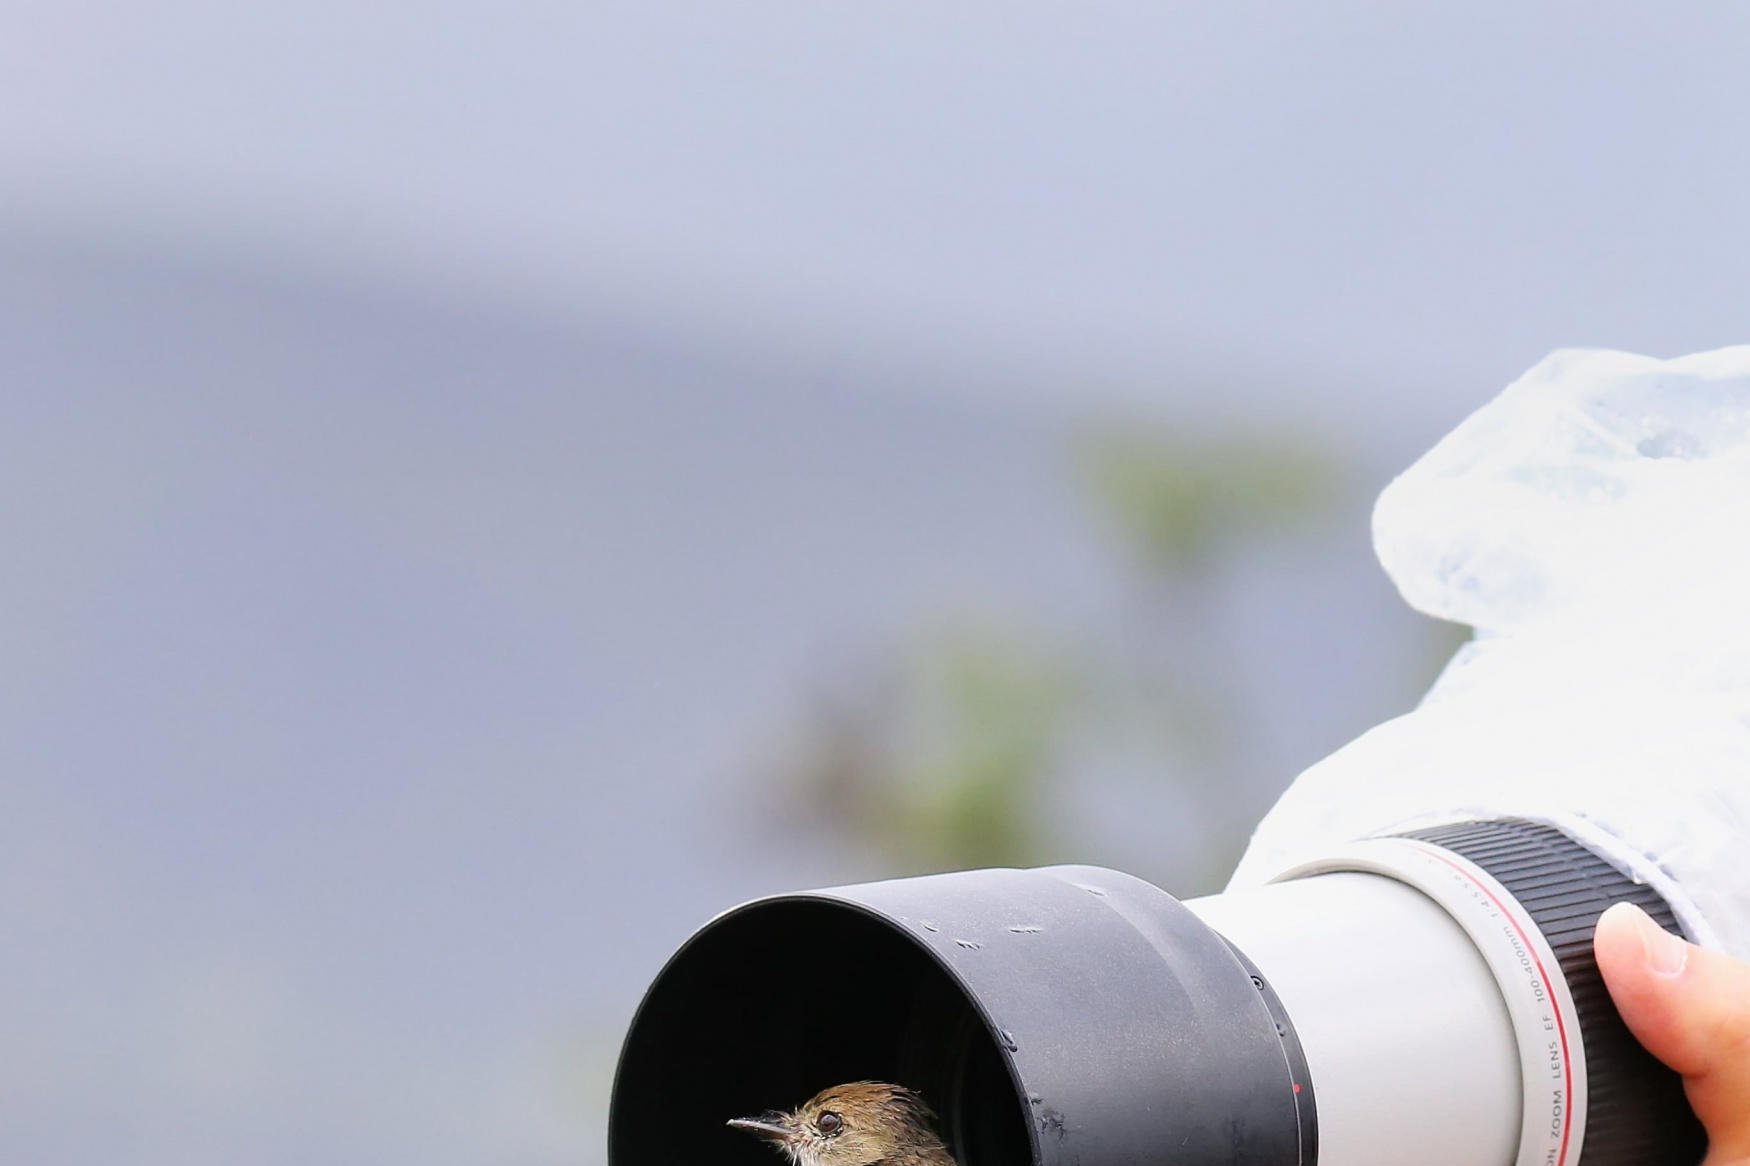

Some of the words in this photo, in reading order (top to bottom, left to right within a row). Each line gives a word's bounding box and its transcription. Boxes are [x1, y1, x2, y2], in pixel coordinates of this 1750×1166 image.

[1503, 925, 1546, 1003] 100-400mm
[1542, 1015, 1554, 1031] EF
[1548, 1041, 1561, 1079] LENS
[1551, 1090, 1562, 1139] ZOOM
